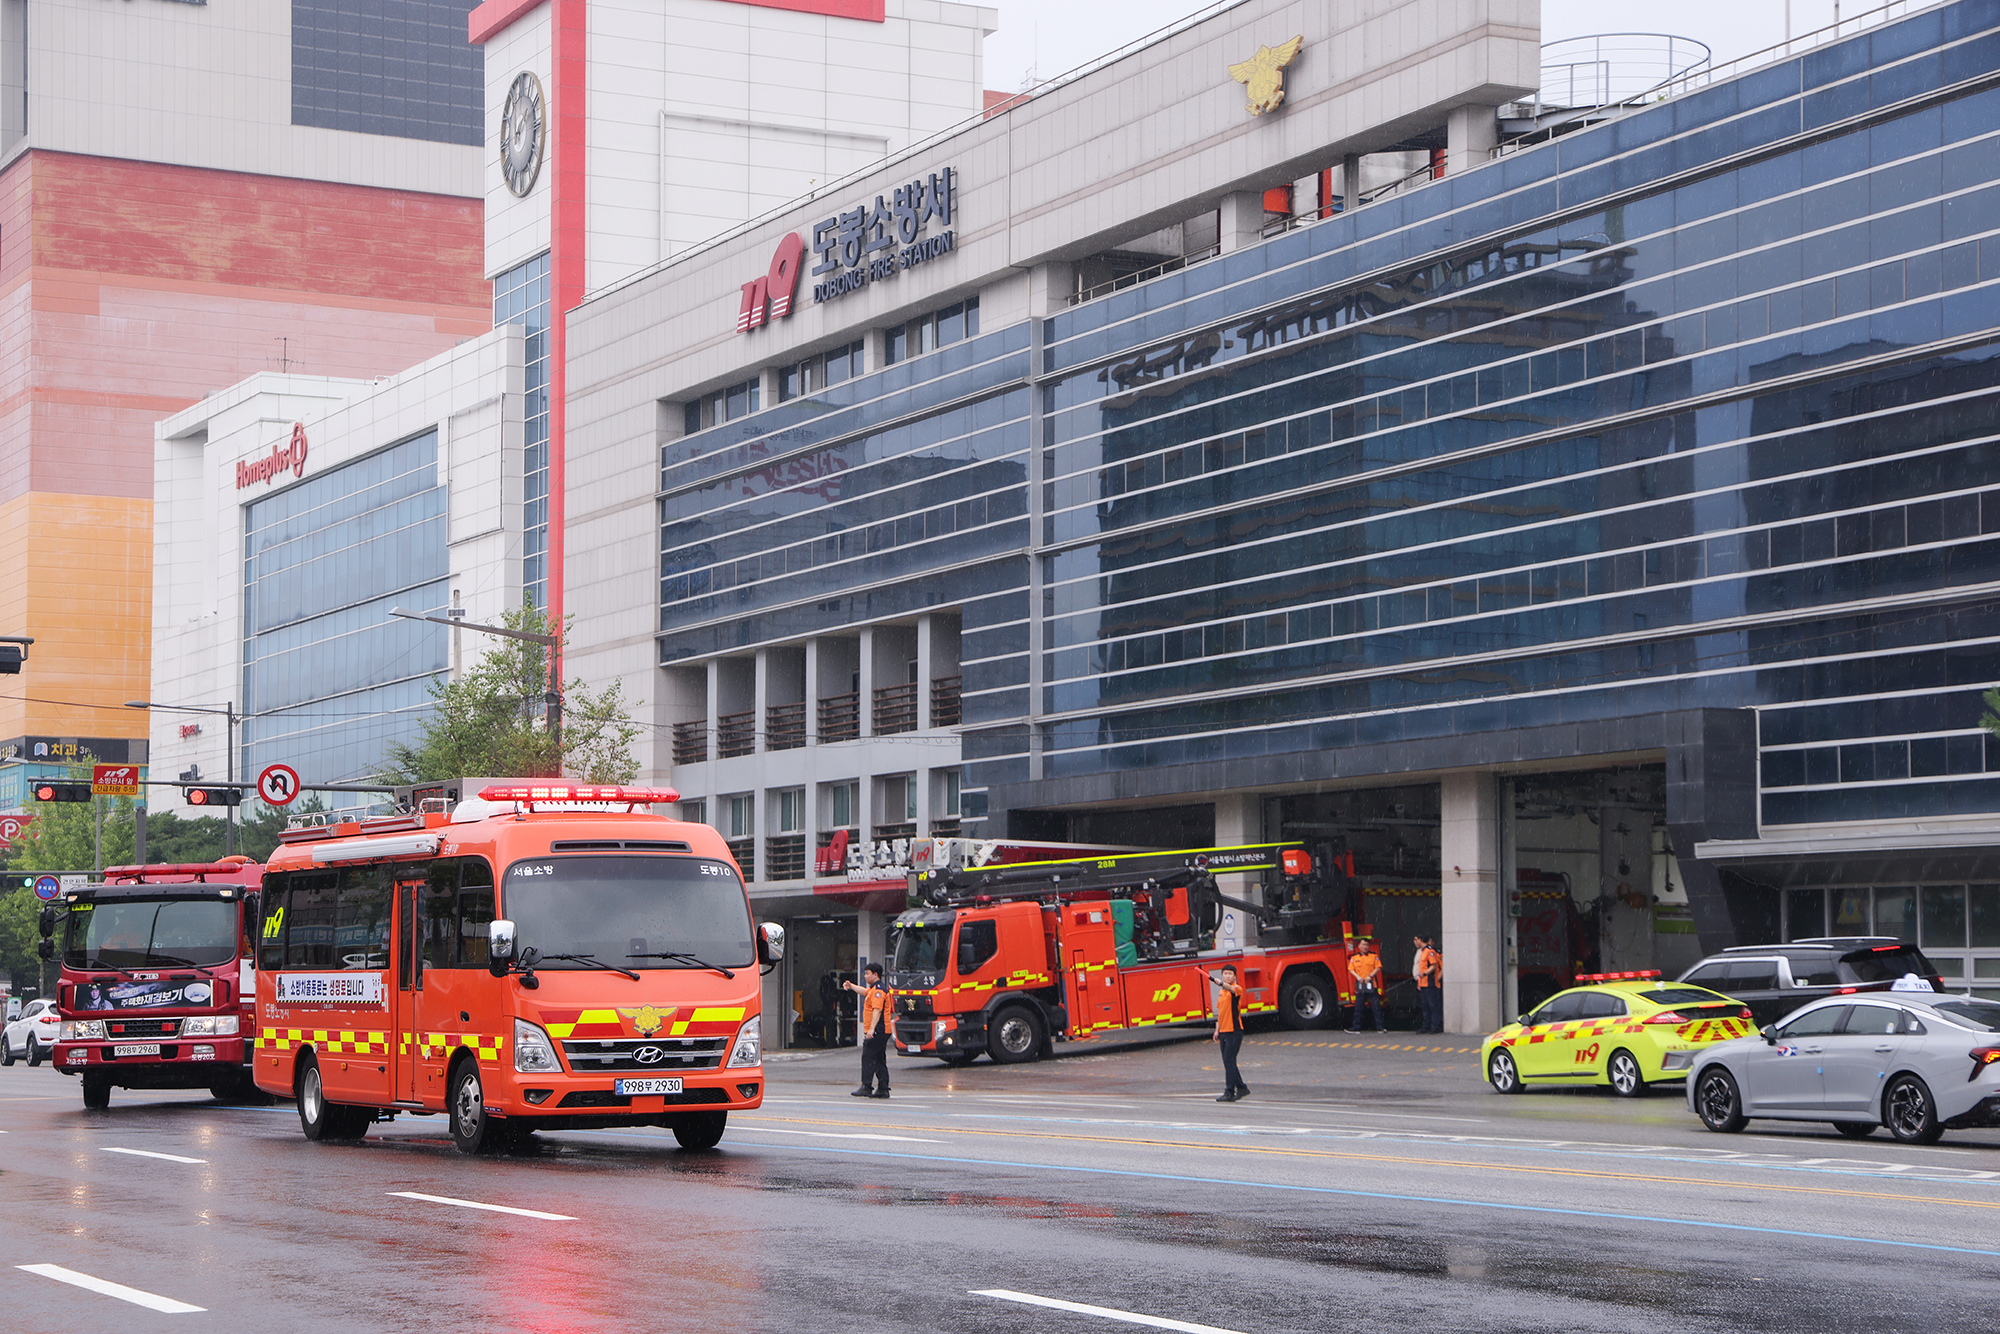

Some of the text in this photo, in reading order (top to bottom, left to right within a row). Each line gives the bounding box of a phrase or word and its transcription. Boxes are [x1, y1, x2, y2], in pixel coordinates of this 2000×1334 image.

[812, 167, 952, 276] 도봉소방서
[813, 230, 953, 304] DOBONG FIRE STATION
[737, 232, 804, 334] 119
[236, 444, 290, 490] Homeplus
[51, 743, 78, 756] 치과
[104, 767, 130, 778] 119
[123, 785, 135, 793] 주의
[814, 829, 849, 872] 119
[916, 846, 931, 862] 119
[513, 865, 554, 877] 서울소방
[700, 865, 731, 877] 도봉10
[1097, 860, 1116, 869] 28M
[918, 871, 928, 881] 119
[263, 906, 285, 938] 119
[329, 979, 364, 996] 생명로입니다
[1151, 982, 1182, 1003] 119
[1914, 982, 1931, 990] TAXI
[138, 1045, 158, 1054] 2960
[1574, 1042, 1600, 1064] 119
[624, 1079, 680, 1093] 998무 2930
